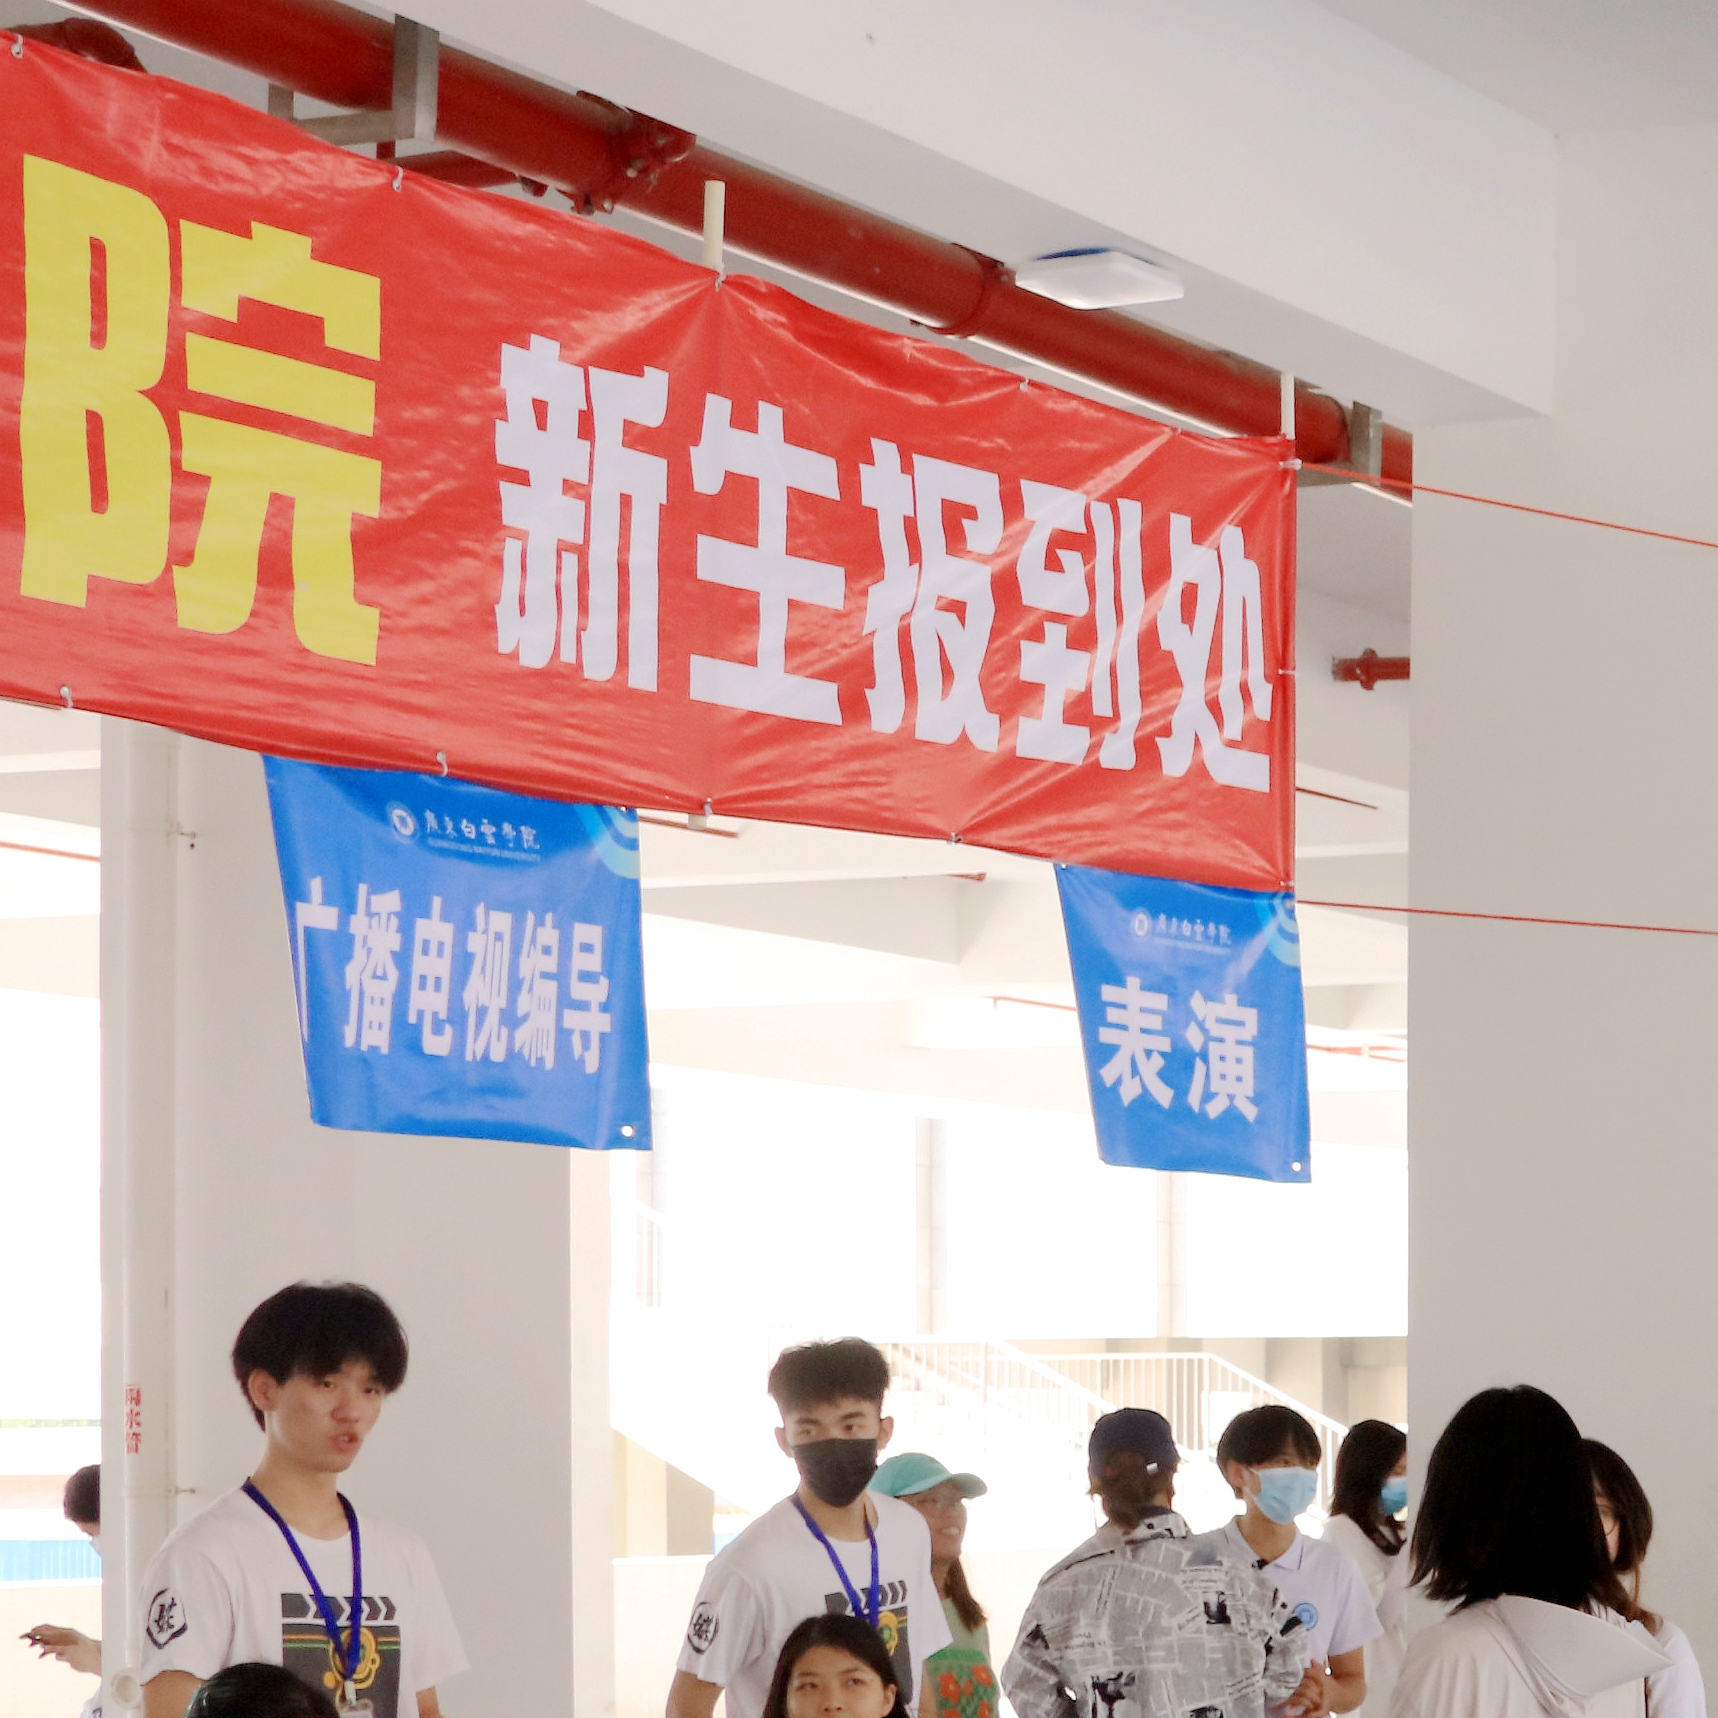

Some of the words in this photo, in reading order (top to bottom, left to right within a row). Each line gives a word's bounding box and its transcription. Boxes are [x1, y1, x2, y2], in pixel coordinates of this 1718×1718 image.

[19, 153, 382, 667] 院
[494, 332, 1274, 794] 新生报到处
[295, 875, 612, 1074] 广播电视编导
[1098, 975, 1260, 1124] 表演
